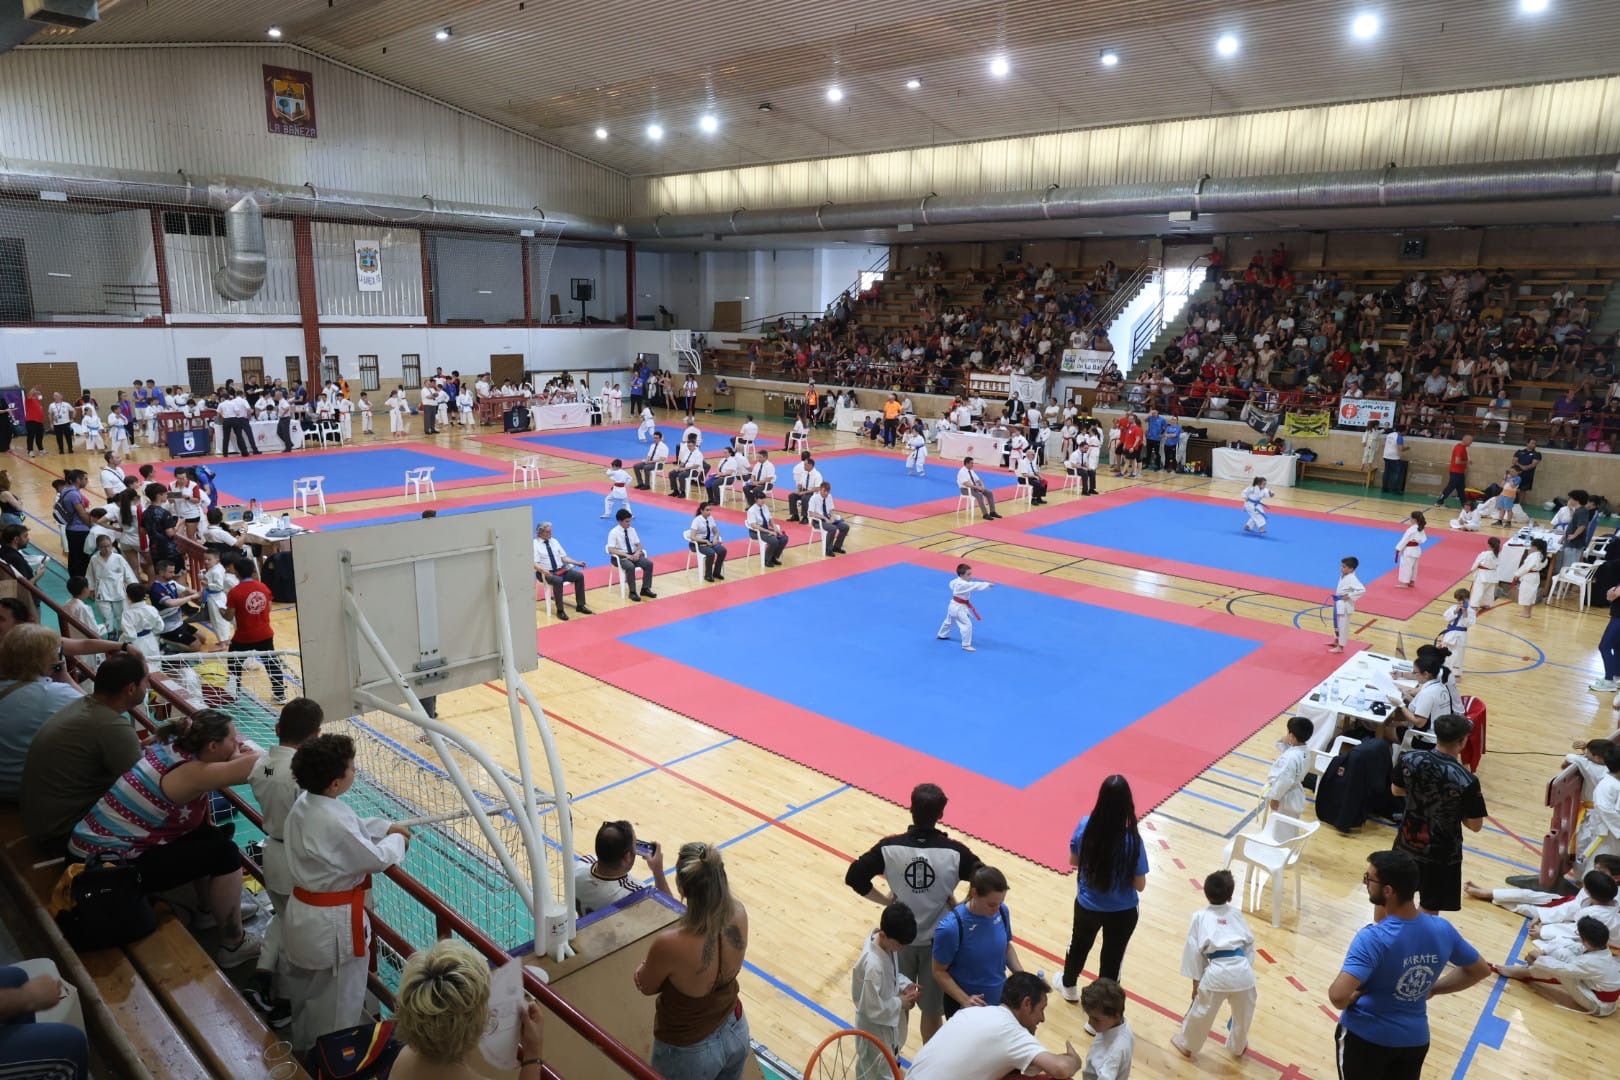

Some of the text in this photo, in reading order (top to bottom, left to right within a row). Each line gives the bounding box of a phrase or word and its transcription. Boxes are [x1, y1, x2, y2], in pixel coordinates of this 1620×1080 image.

[269, 122, 281, 133] LA
[972, 381, 1006, 392] PRENSA
[1403, 954, 1439, 968] KARATE
